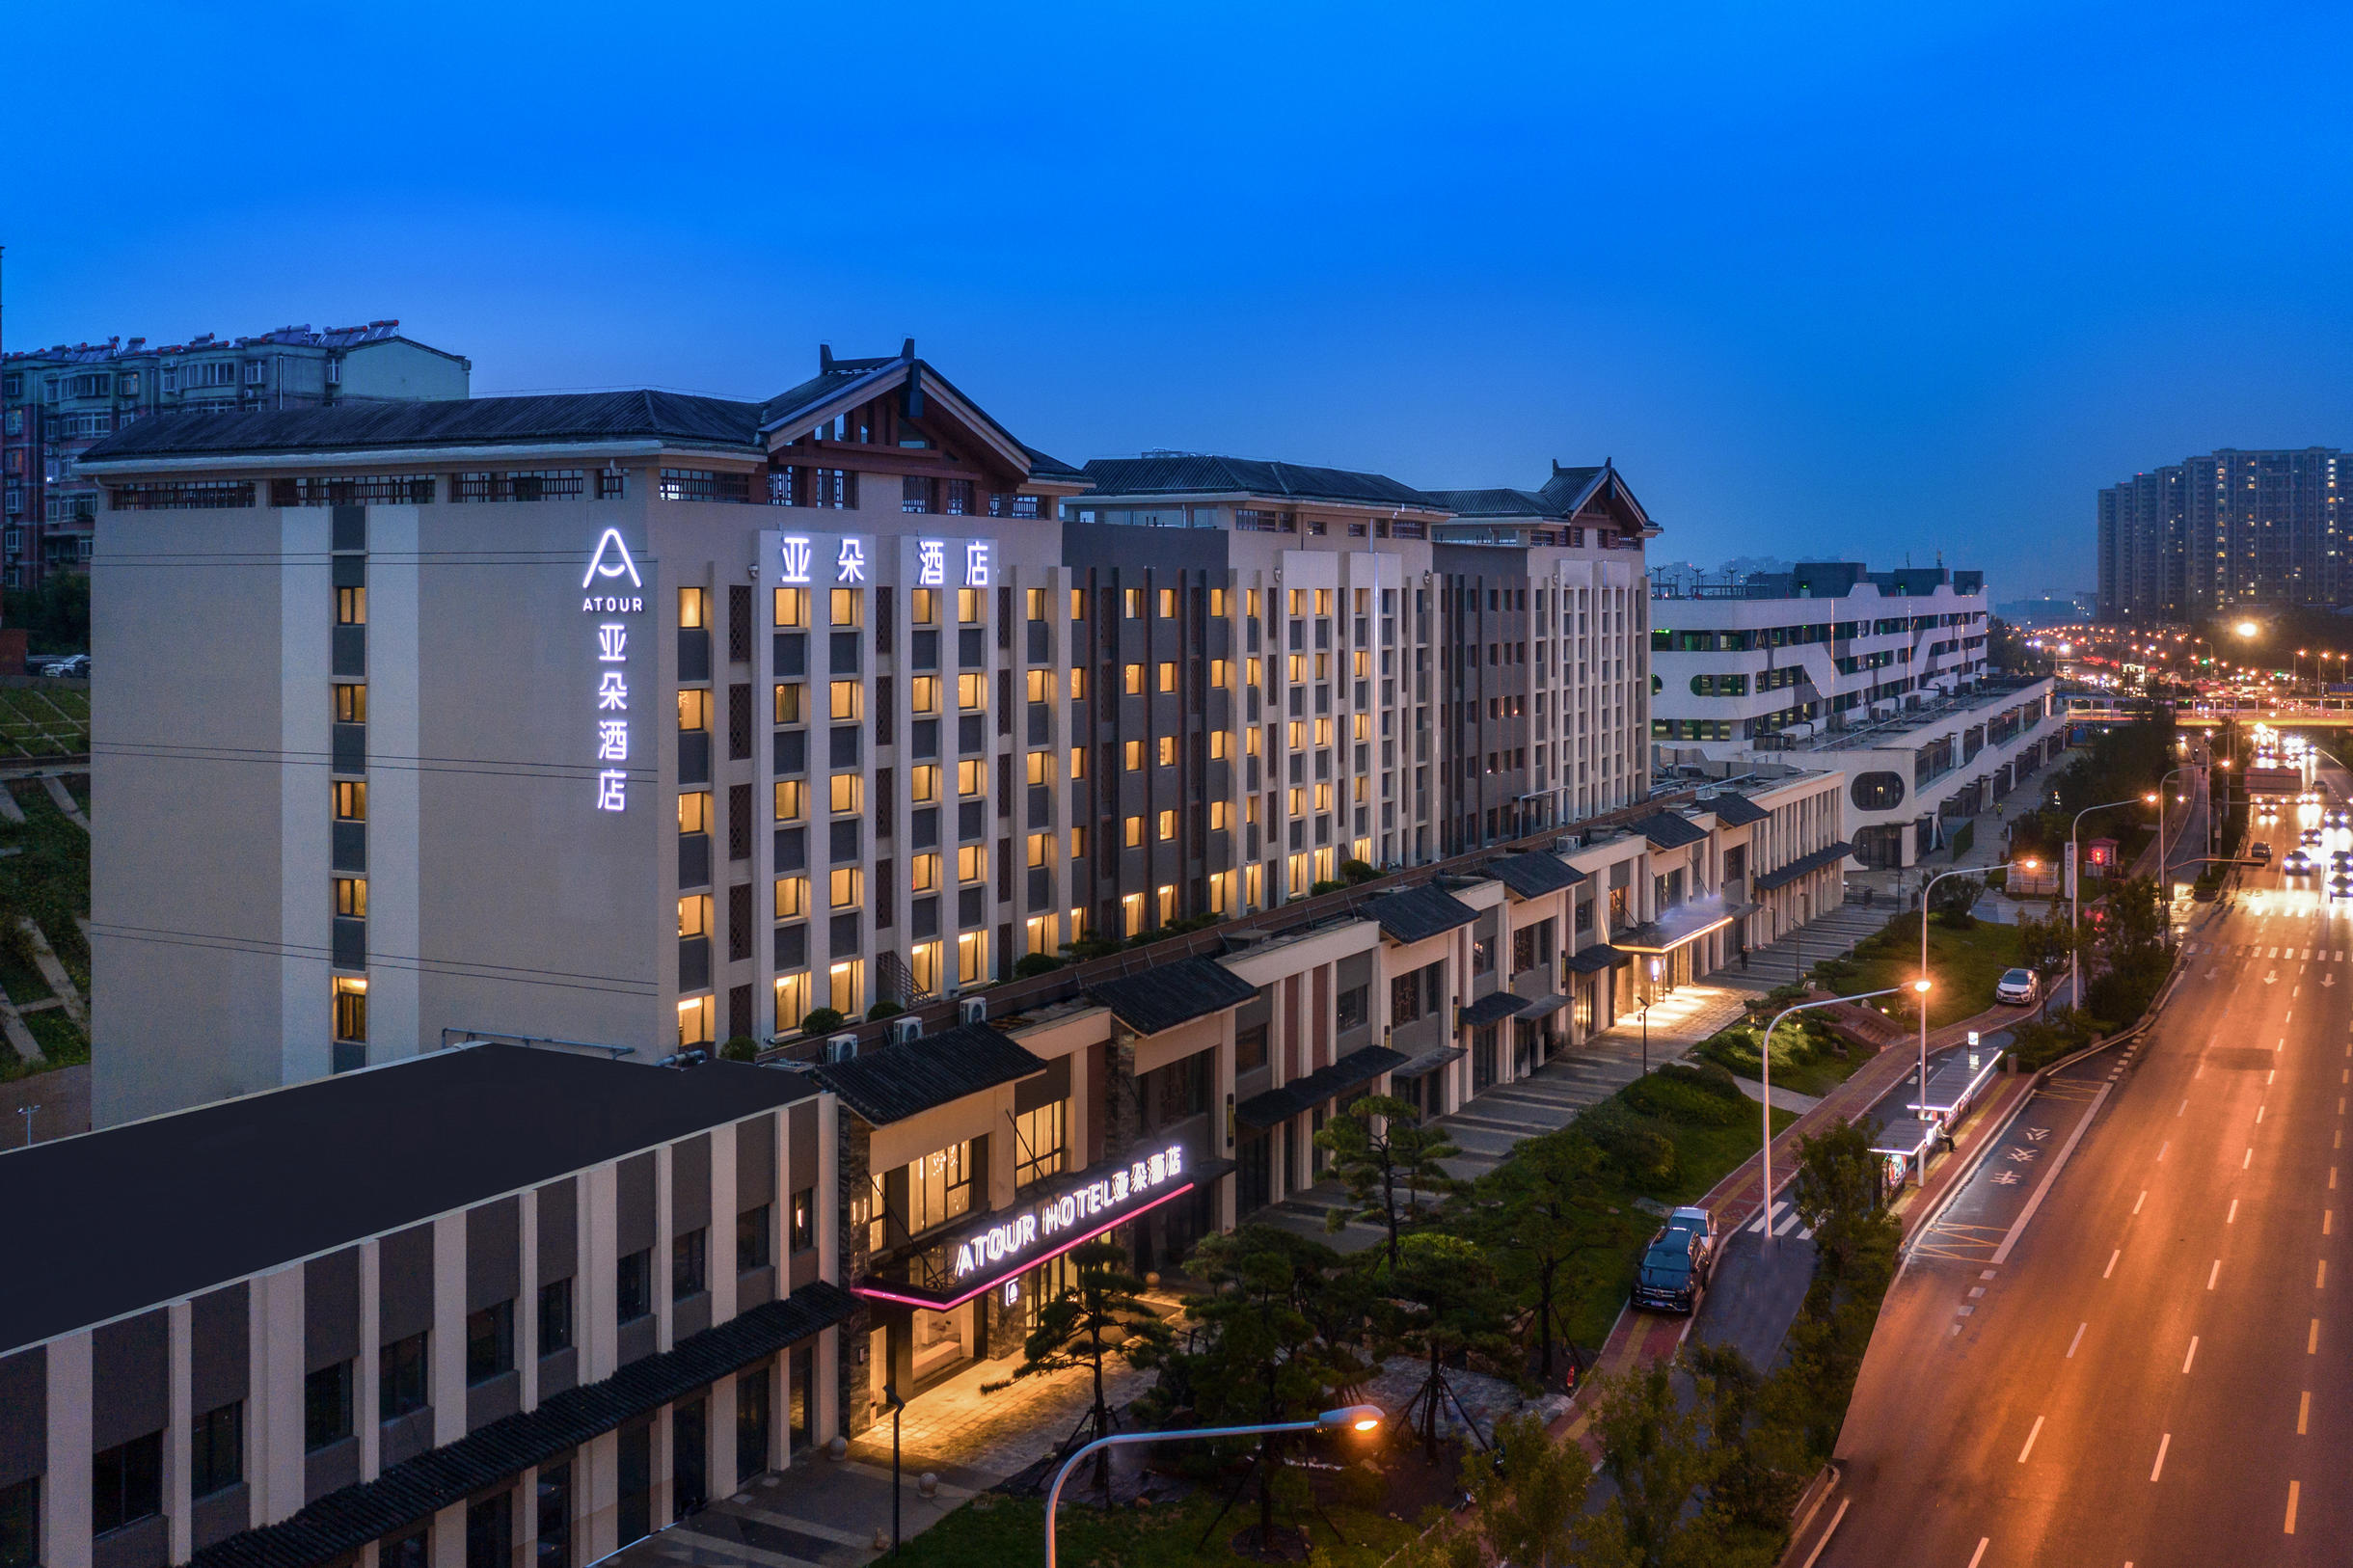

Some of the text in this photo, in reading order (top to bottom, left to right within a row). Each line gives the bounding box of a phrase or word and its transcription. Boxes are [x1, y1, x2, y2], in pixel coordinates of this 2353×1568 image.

[782, 536, 988, 585] 亚朵酒店
[582, 597, 643, 612] ATOUR
[597, 623, 628, 811] 亚朵酒店
[955, 1214, 1036, 1277] ATOUR
[1042, 1179, 1115, 1235] HOTEL
